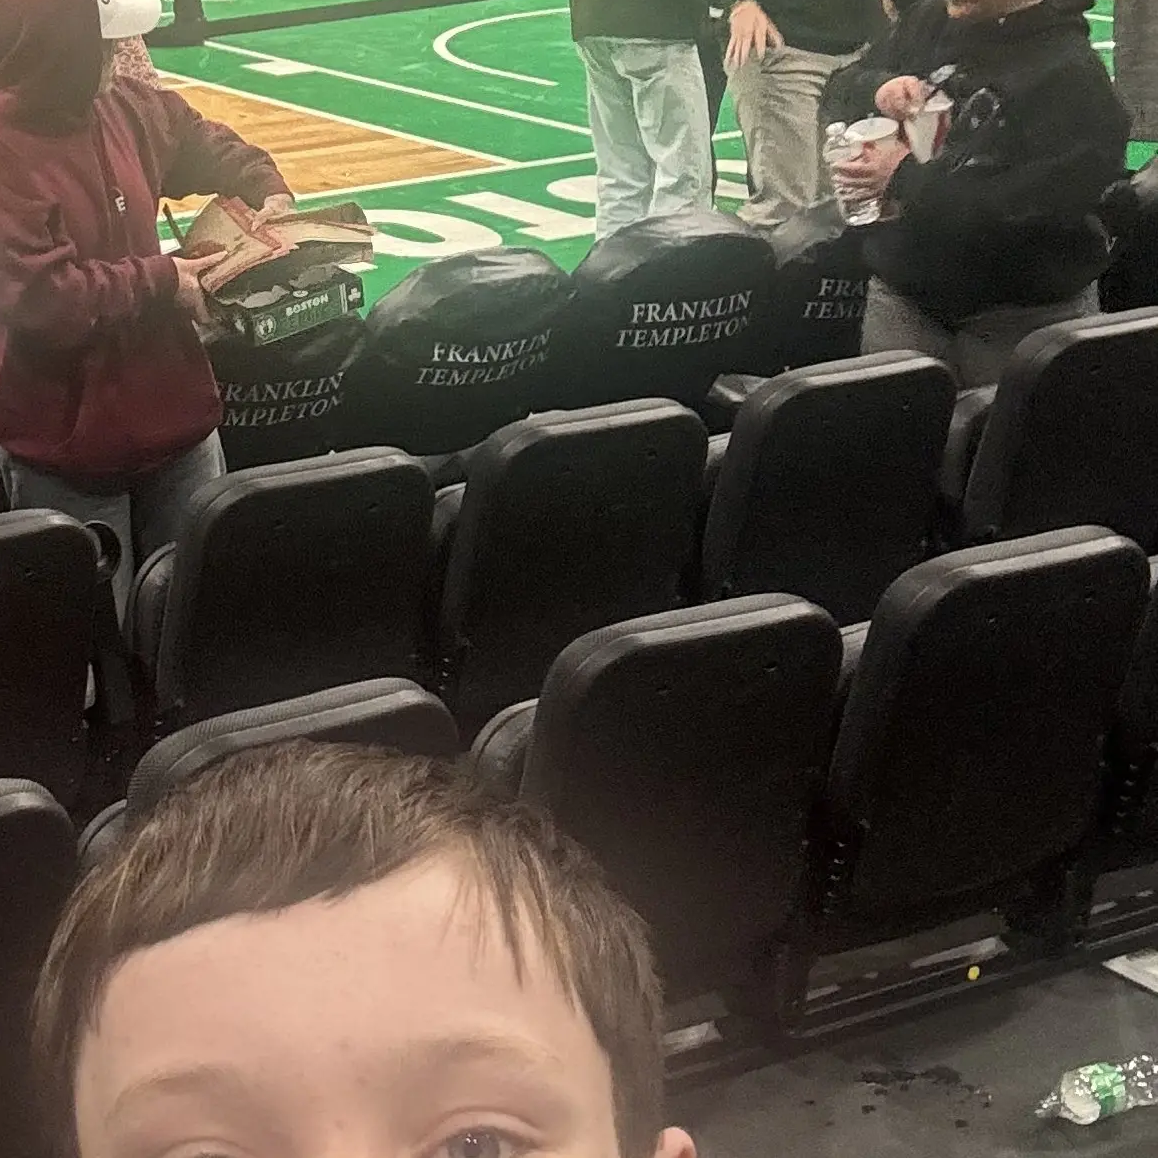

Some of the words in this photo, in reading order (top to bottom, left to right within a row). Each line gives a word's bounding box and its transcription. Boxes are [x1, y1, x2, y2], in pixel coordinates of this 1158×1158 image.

[285, 294, 330, 317] BOSTON
[632, 290, 753, 324] FRANKLIN
[432, 328, 552, 363] FRANKLIN
[616, 315, 749, 348] TEMPLETON
[414, 351, 549, 387] TEMPLETON
